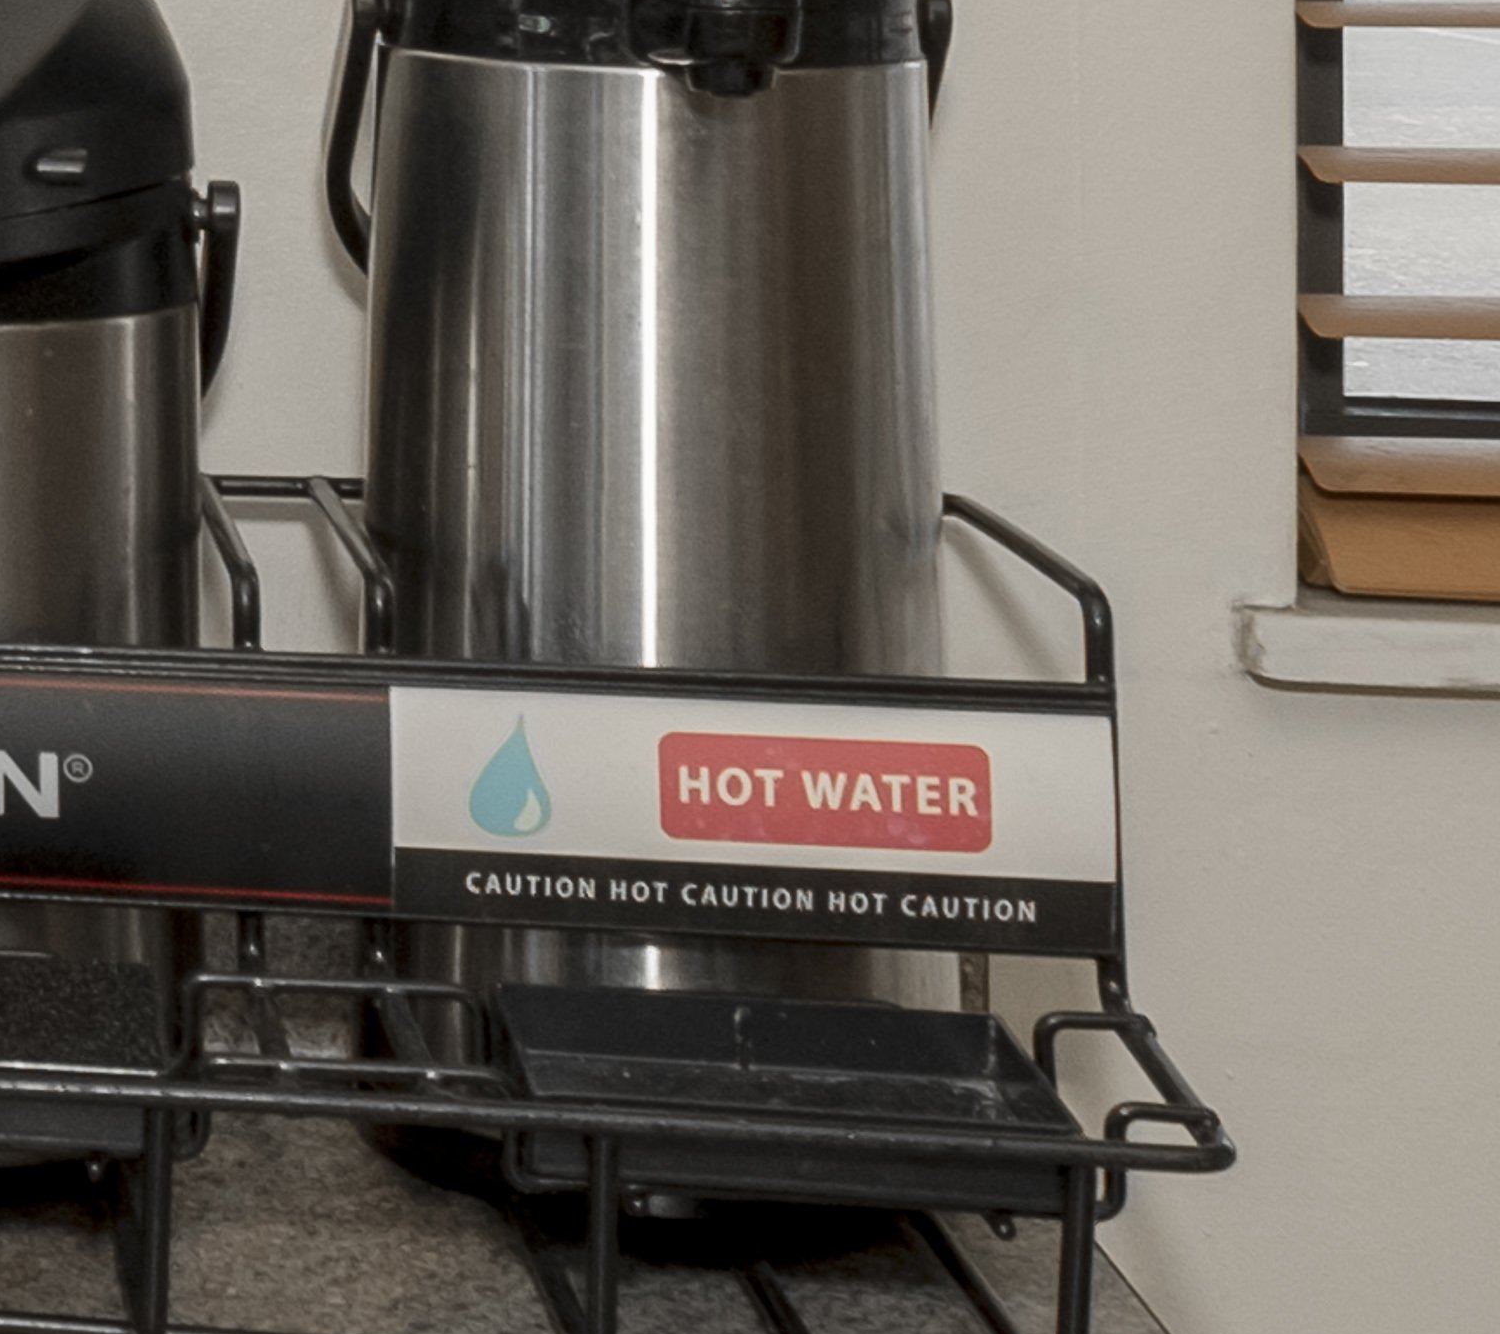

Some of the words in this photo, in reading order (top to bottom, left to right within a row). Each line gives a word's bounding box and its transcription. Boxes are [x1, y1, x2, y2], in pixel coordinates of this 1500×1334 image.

[678, 765, 784, 808] HOT
[802, 770, 979, 817] WATER
[464, 870, 597, 900] CAUTION
[609, 879, 669, 904] HOT
[681, 882, 814, 912] CAUTION
[827, 889, 888, 916] HOT
[900, 894, 1037, 923] CAUTION
